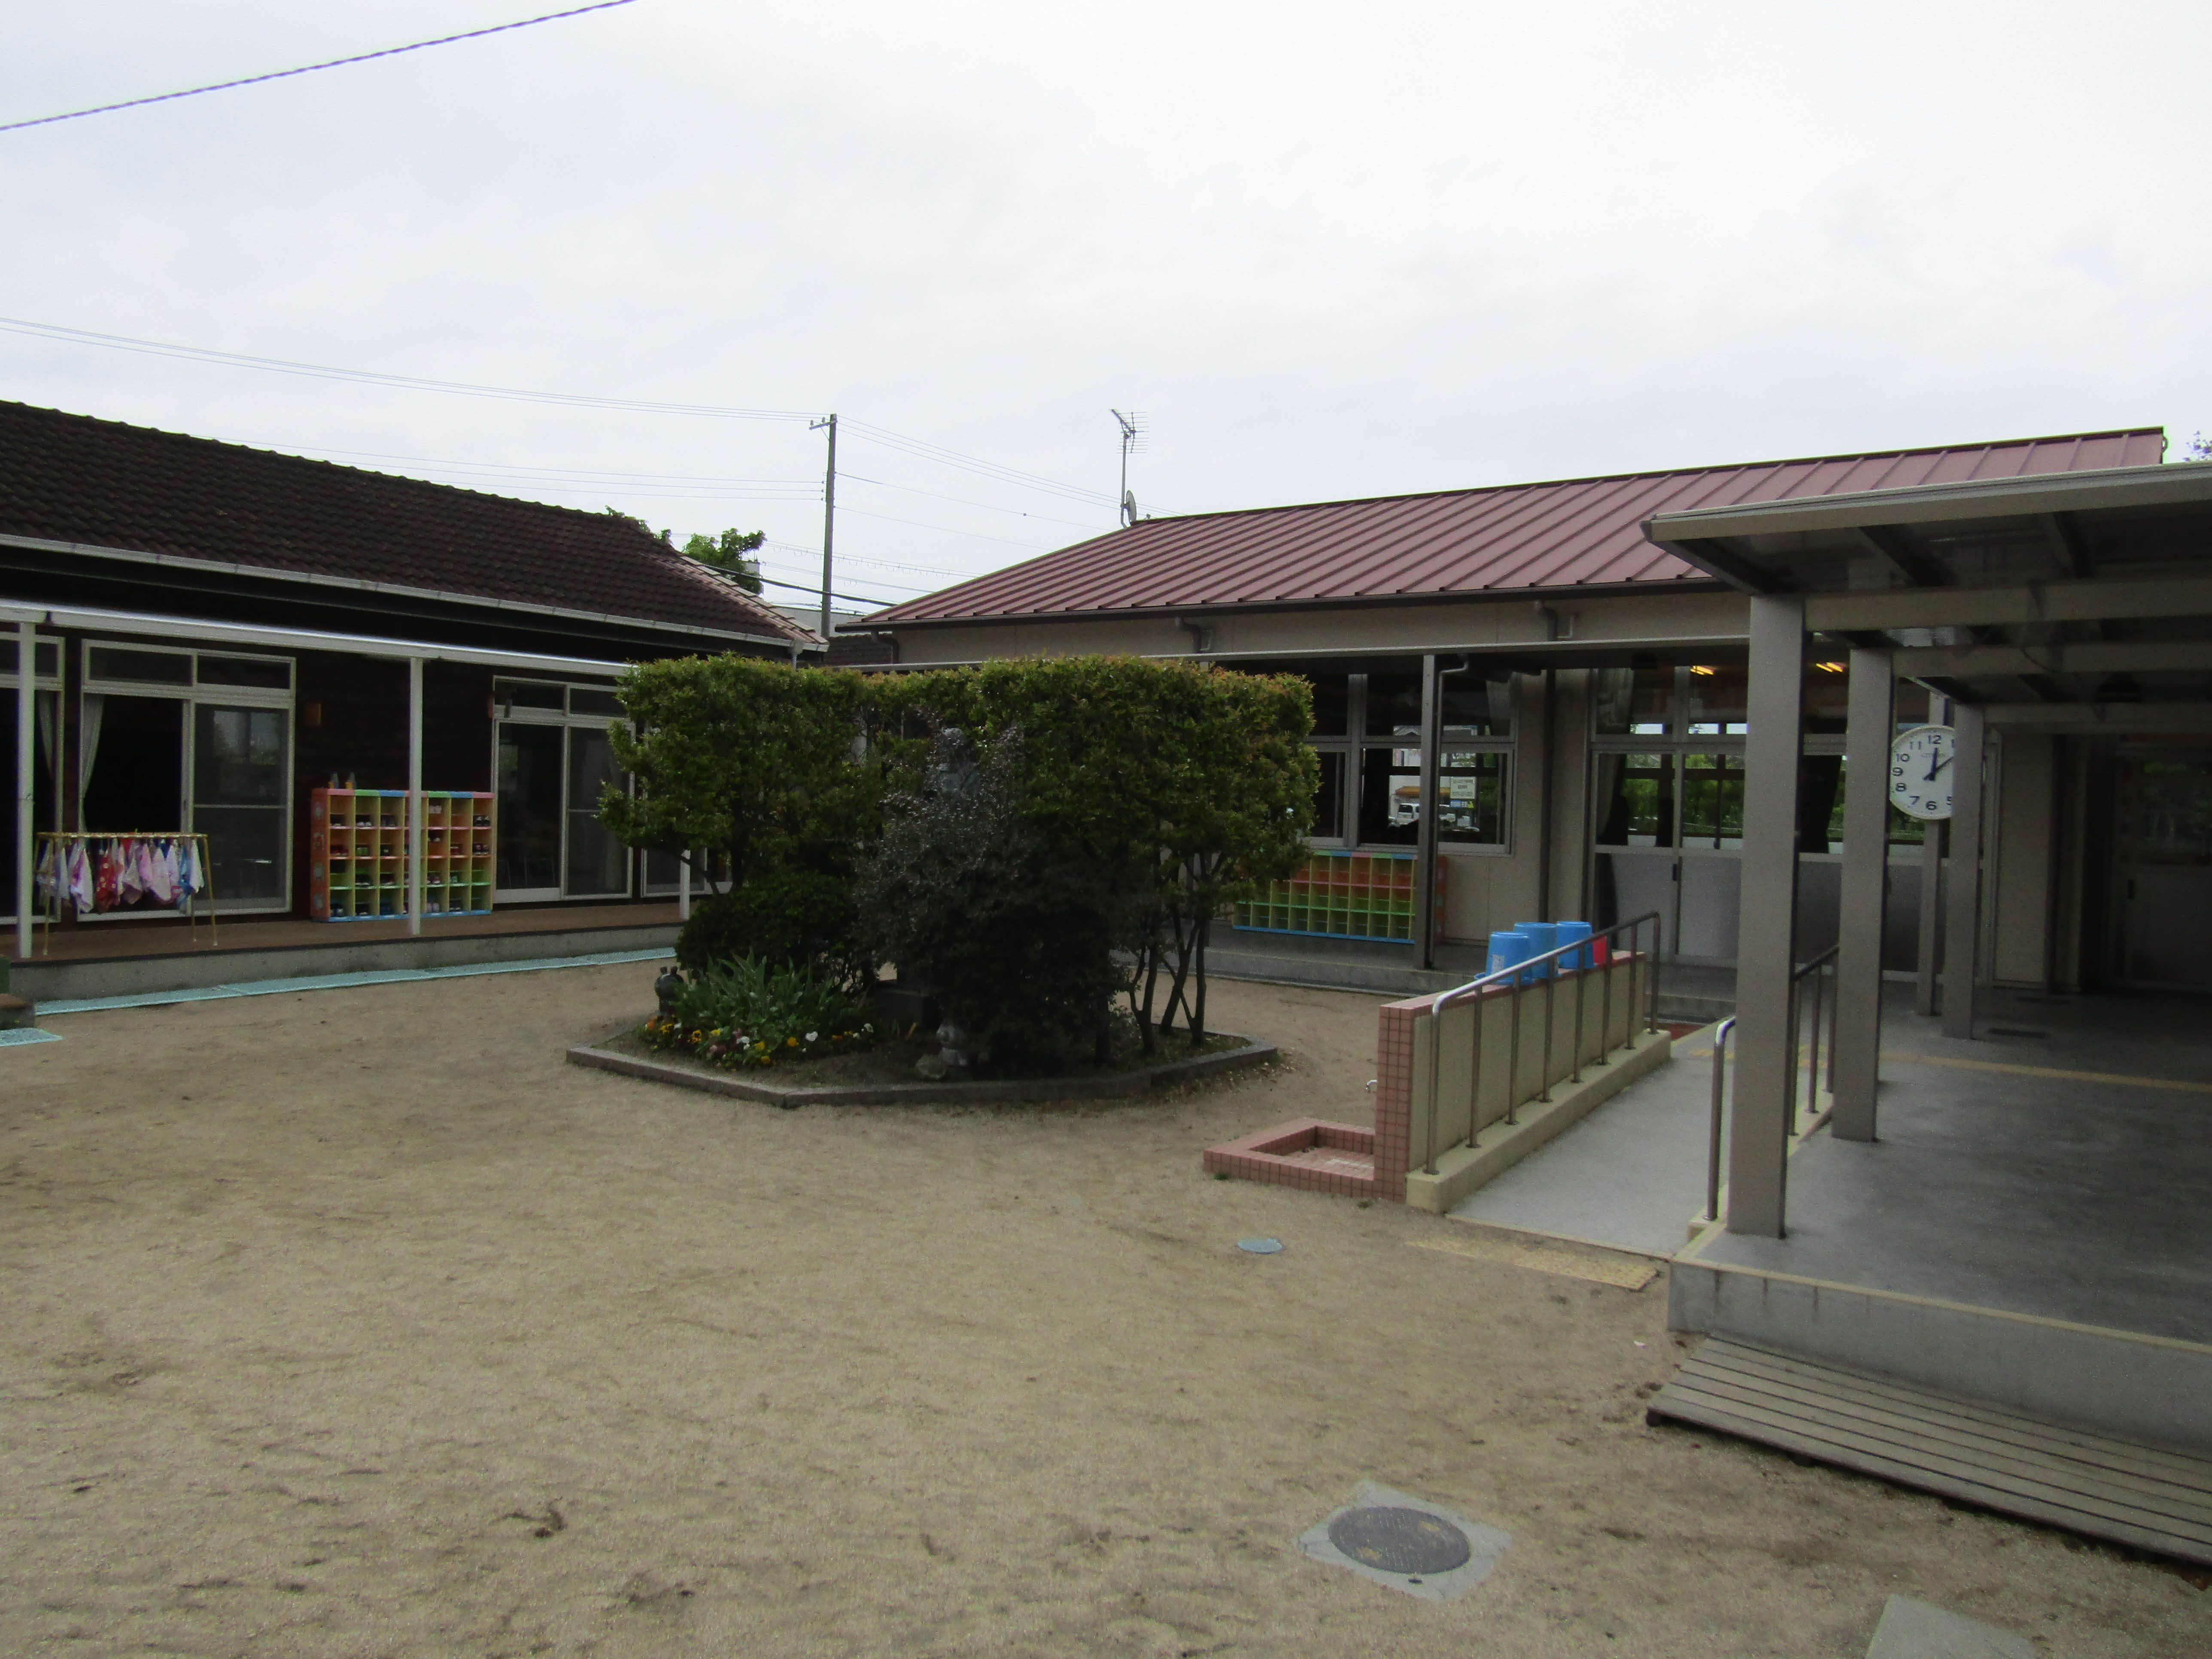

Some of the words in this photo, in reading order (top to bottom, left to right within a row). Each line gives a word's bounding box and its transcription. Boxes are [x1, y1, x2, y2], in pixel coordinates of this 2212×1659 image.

[1928, 735, 1942, 744] 12
[1909, 741, 1922, 750] 11
[1896, 753, 1910, 762] 10
[1892, 767, 1903, 776] 9
[1896, 783, 1906, 792] 8
[1909, 796, 1920, 805] 7
[1926, 801, 1938, 810] 6
